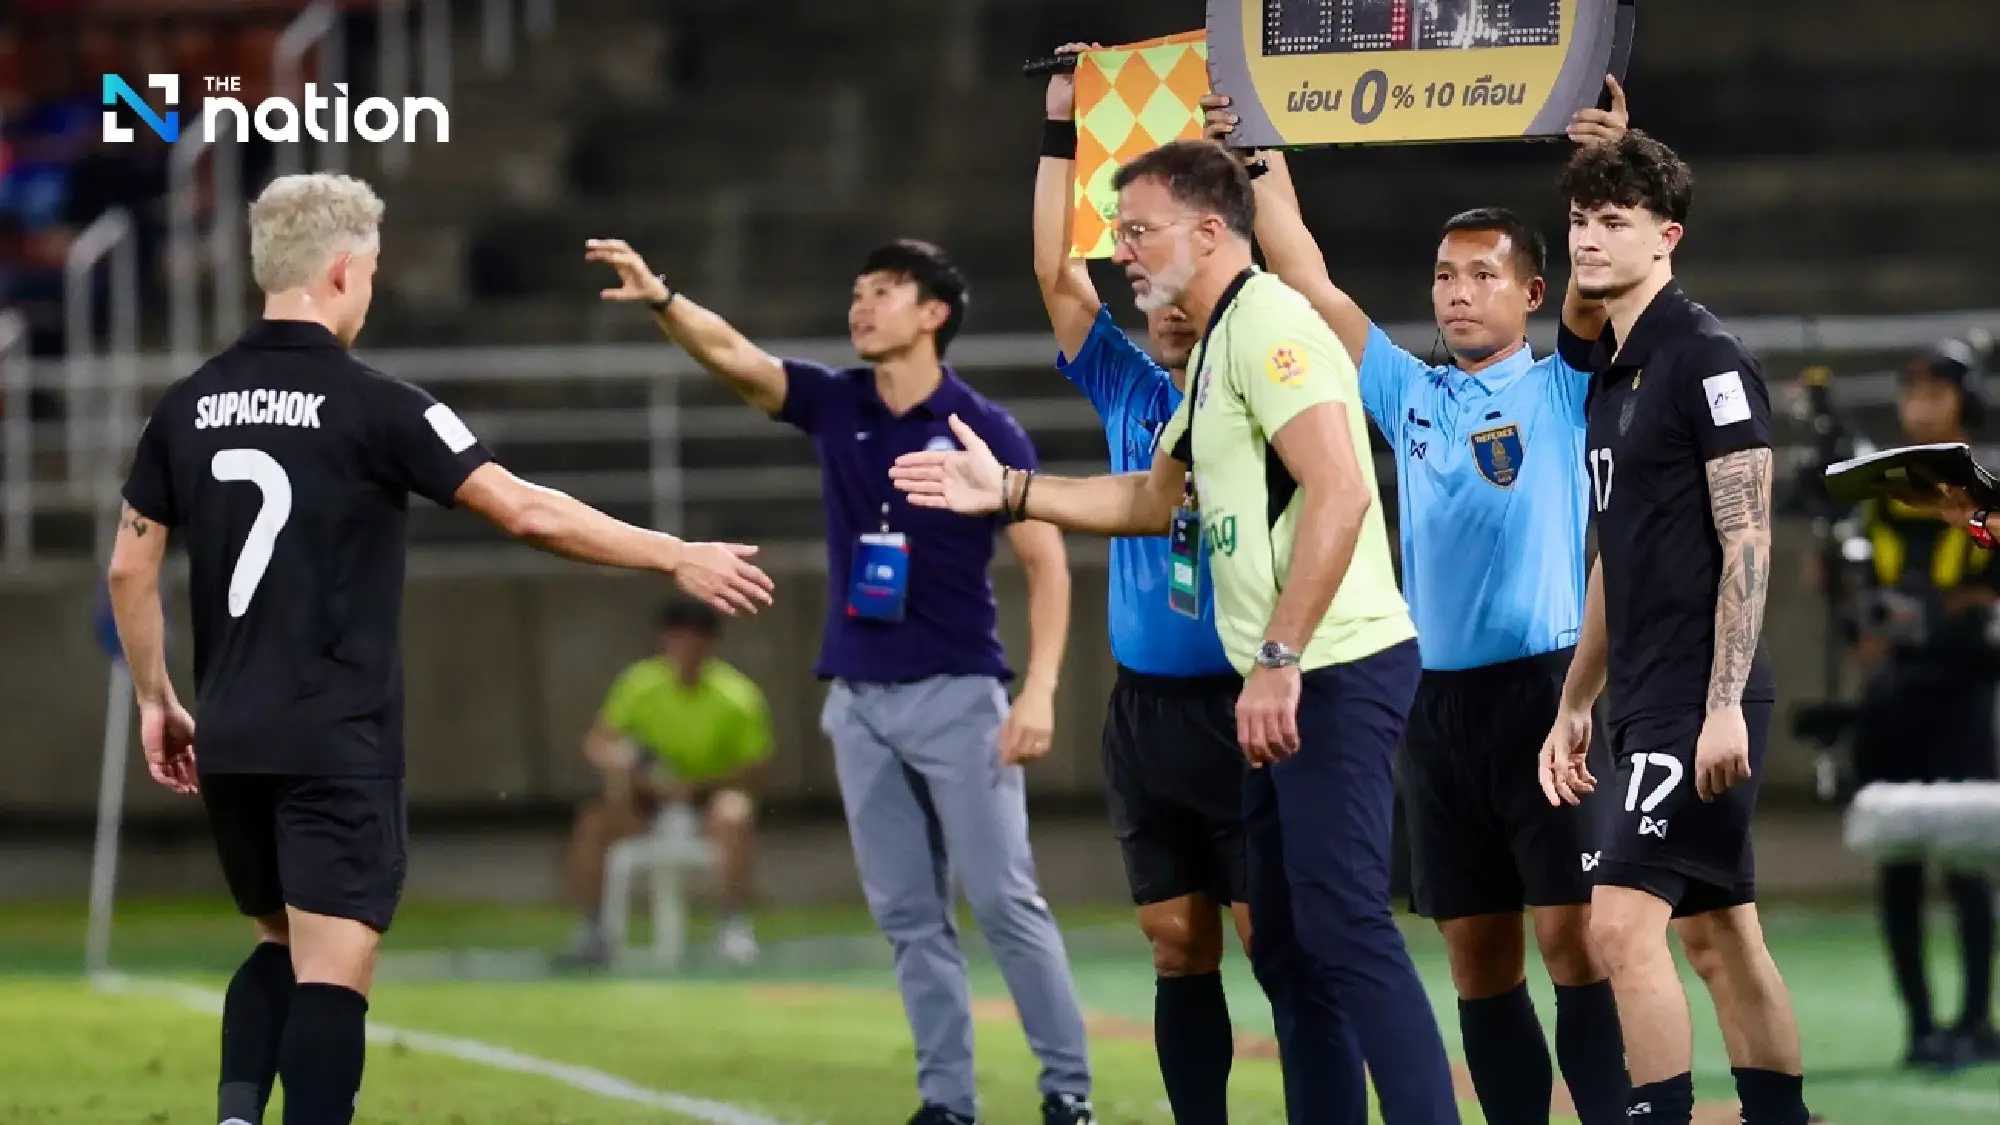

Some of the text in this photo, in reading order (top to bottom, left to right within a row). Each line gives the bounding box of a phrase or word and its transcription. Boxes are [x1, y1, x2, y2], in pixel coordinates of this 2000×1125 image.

[1287, 81, 1343, 113] ผ่อน
[1424, 82, 1455, 109] 10
[1462, 74, 1527, 107] เดือน
[195, 388, 326, 429] SUPACHOK
[1590, 447, 1615, 513] 17
[211, 448, 293, 618] 7
[1625, 752, 1684, 813] 17
